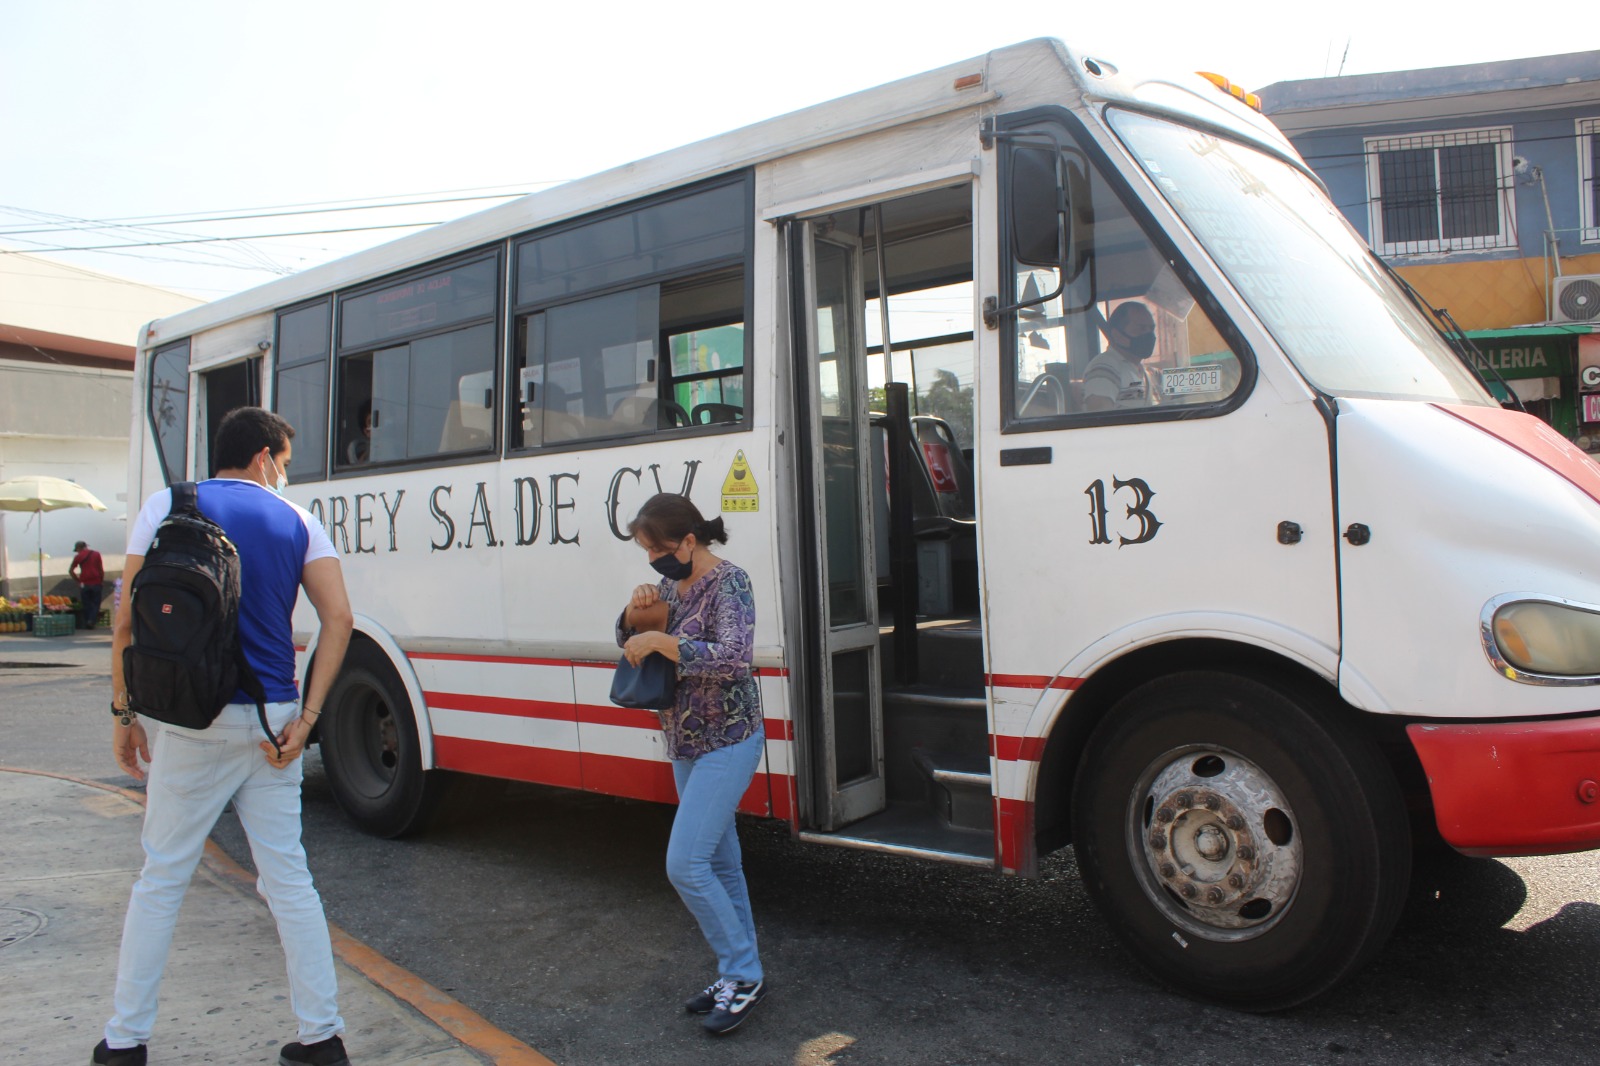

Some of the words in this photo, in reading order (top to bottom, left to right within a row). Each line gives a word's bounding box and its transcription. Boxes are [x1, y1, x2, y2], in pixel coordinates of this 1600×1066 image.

[1465, 347, 1547, 370] ILLERIA
[1166, 371, 1217, 388] 202-820-B
[1084, 474, 1164, 549] 13
